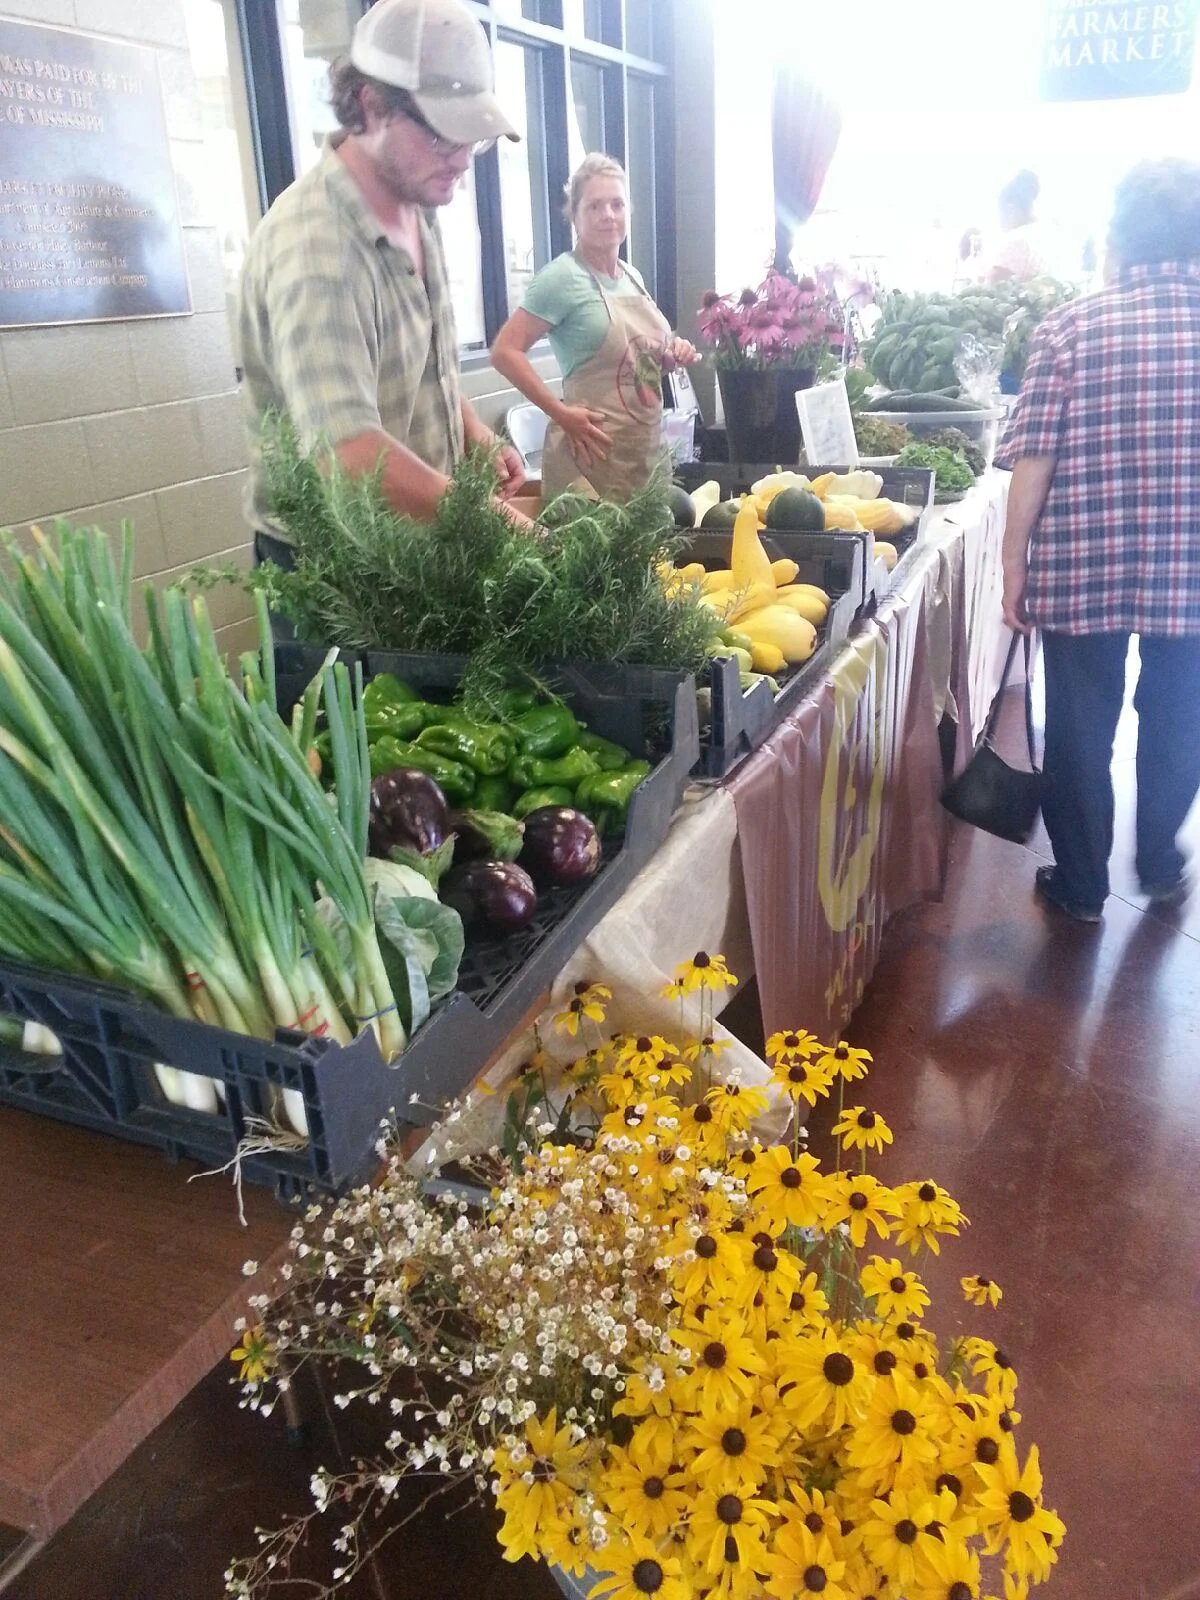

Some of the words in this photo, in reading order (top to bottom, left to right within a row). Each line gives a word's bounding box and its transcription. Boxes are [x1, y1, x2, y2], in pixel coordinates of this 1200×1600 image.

[1051, 31, 1191, 67] MARKET
[34, 59, 70, 81] PAID
[72, 68, 99, 87] FOR
[47, 86, 63, 105] OF
[6, 105, 24, 125] OF
